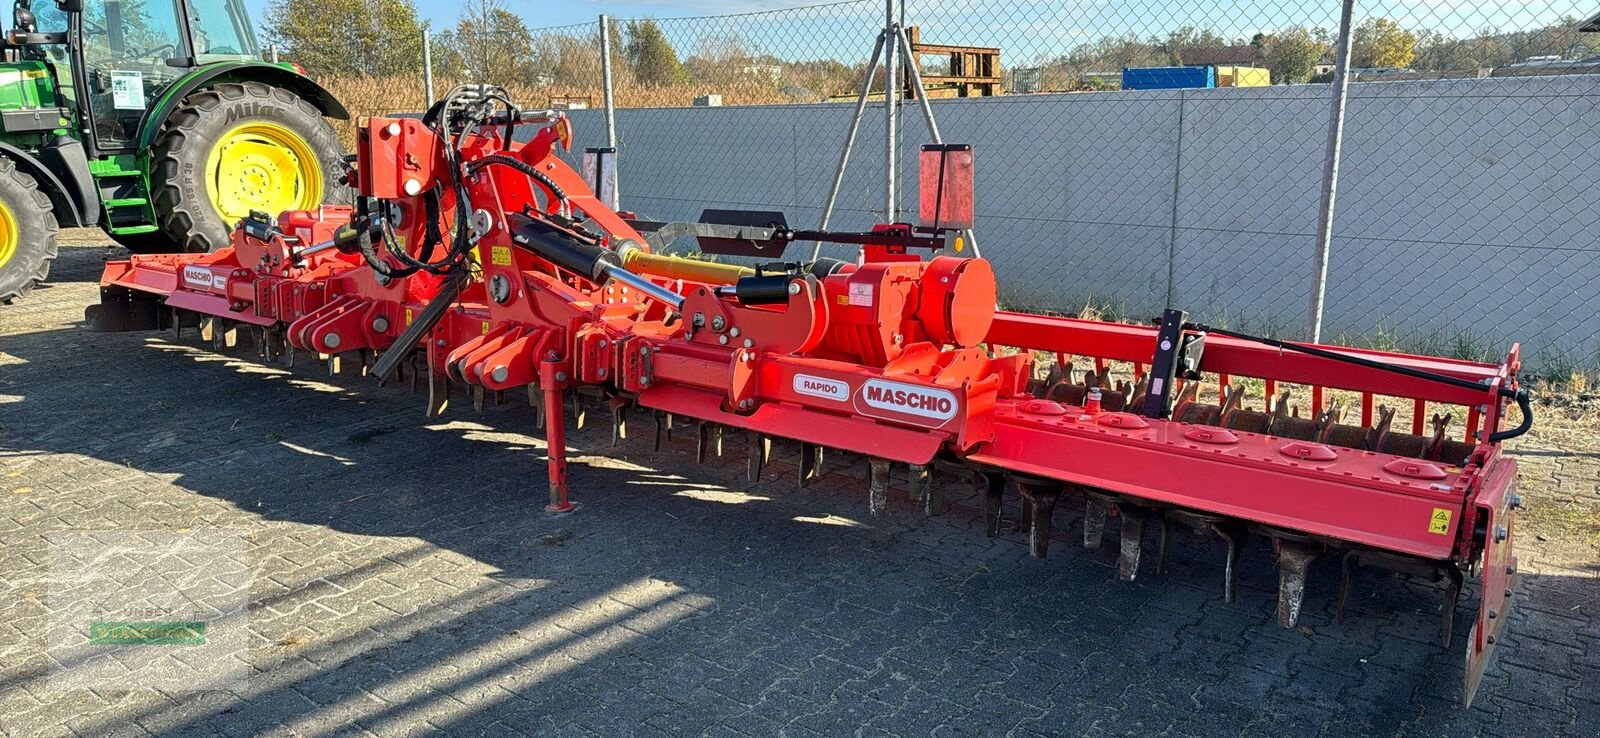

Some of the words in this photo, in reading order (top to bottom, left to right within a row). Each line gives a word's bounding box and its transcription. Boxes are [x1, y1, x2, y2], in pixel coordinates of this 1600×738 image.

[224, 102, 285, 126] Mitas
[186, 270, 210, 282] MASCHIO
[804, 381, 838, 394] RAPIDO
[867, 386, 952, 414] MASCHIO
